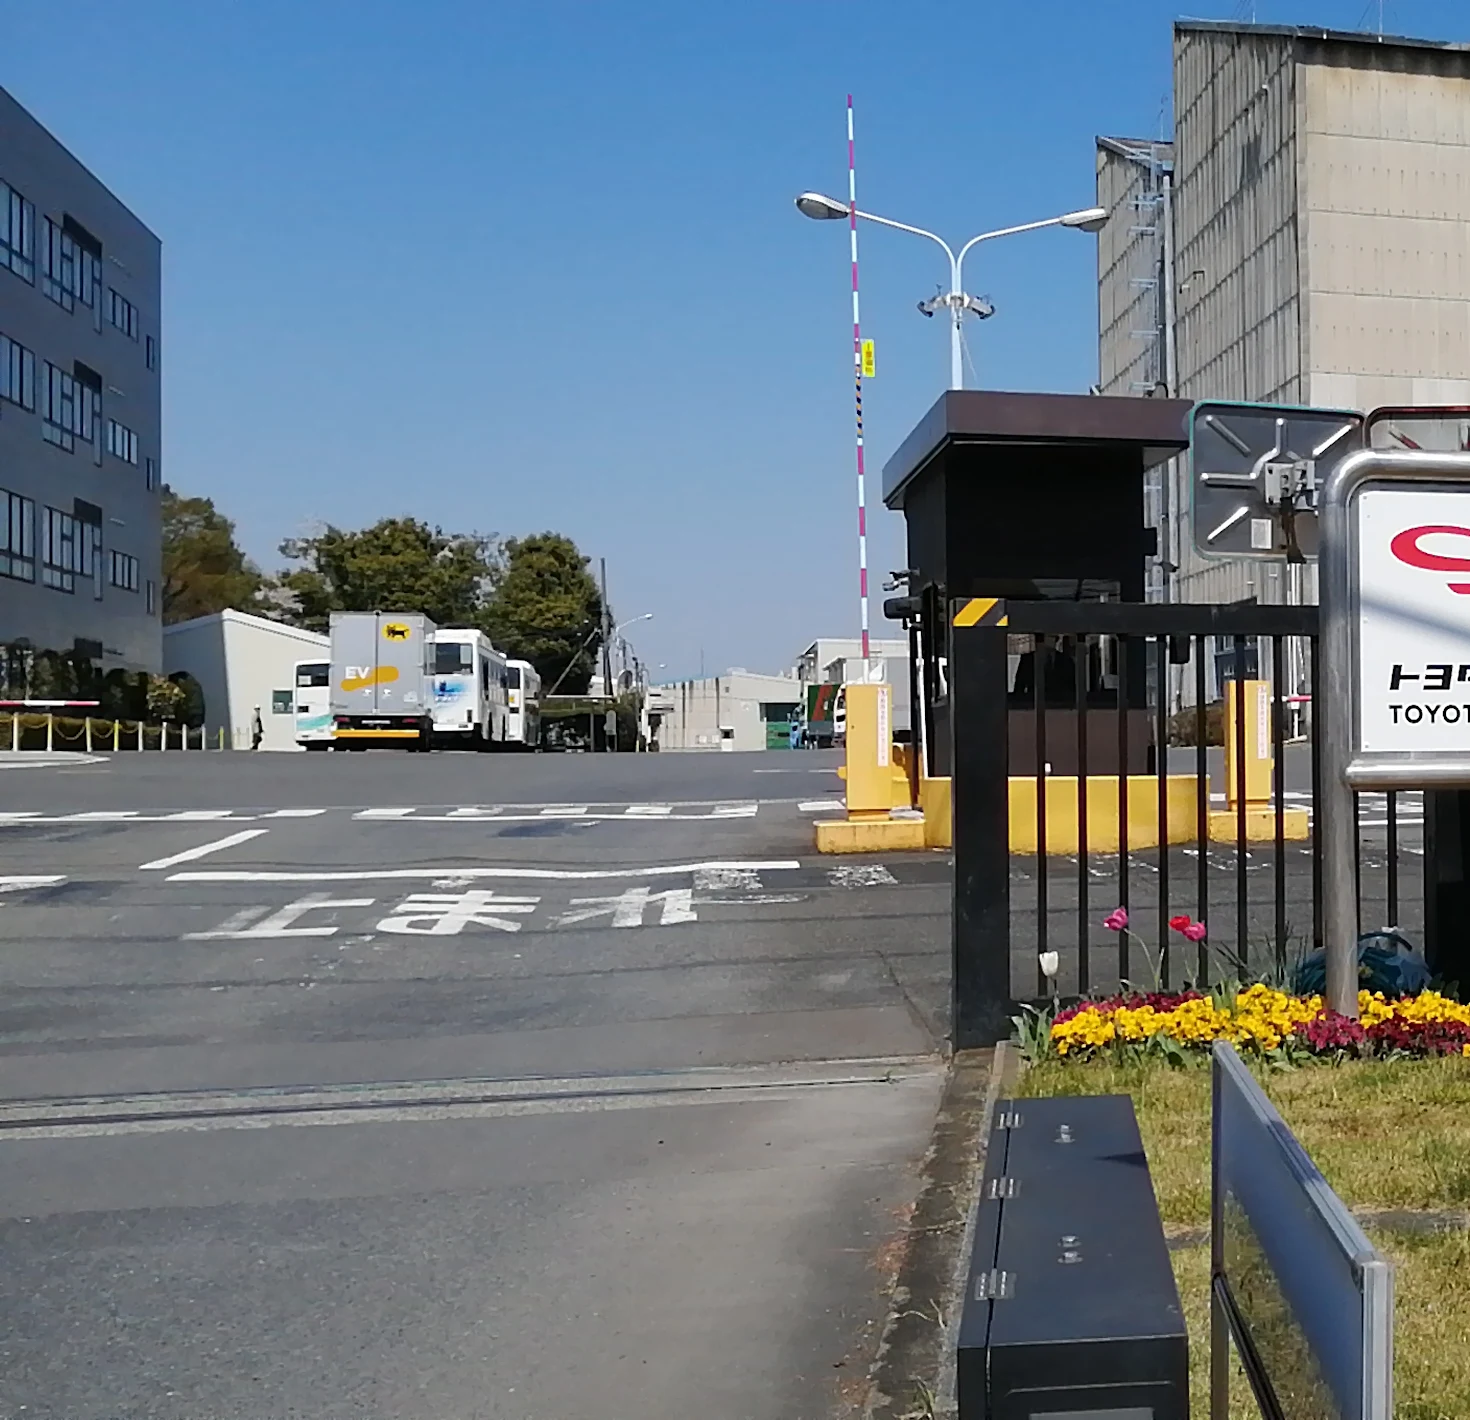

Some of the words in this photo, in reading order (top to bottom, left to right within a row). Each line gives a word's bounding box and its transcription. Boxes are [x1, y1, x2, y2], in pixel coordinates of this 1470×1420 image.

[345, 667, 370, 680] EV
[180, 886, 698, 940] 止まれ
